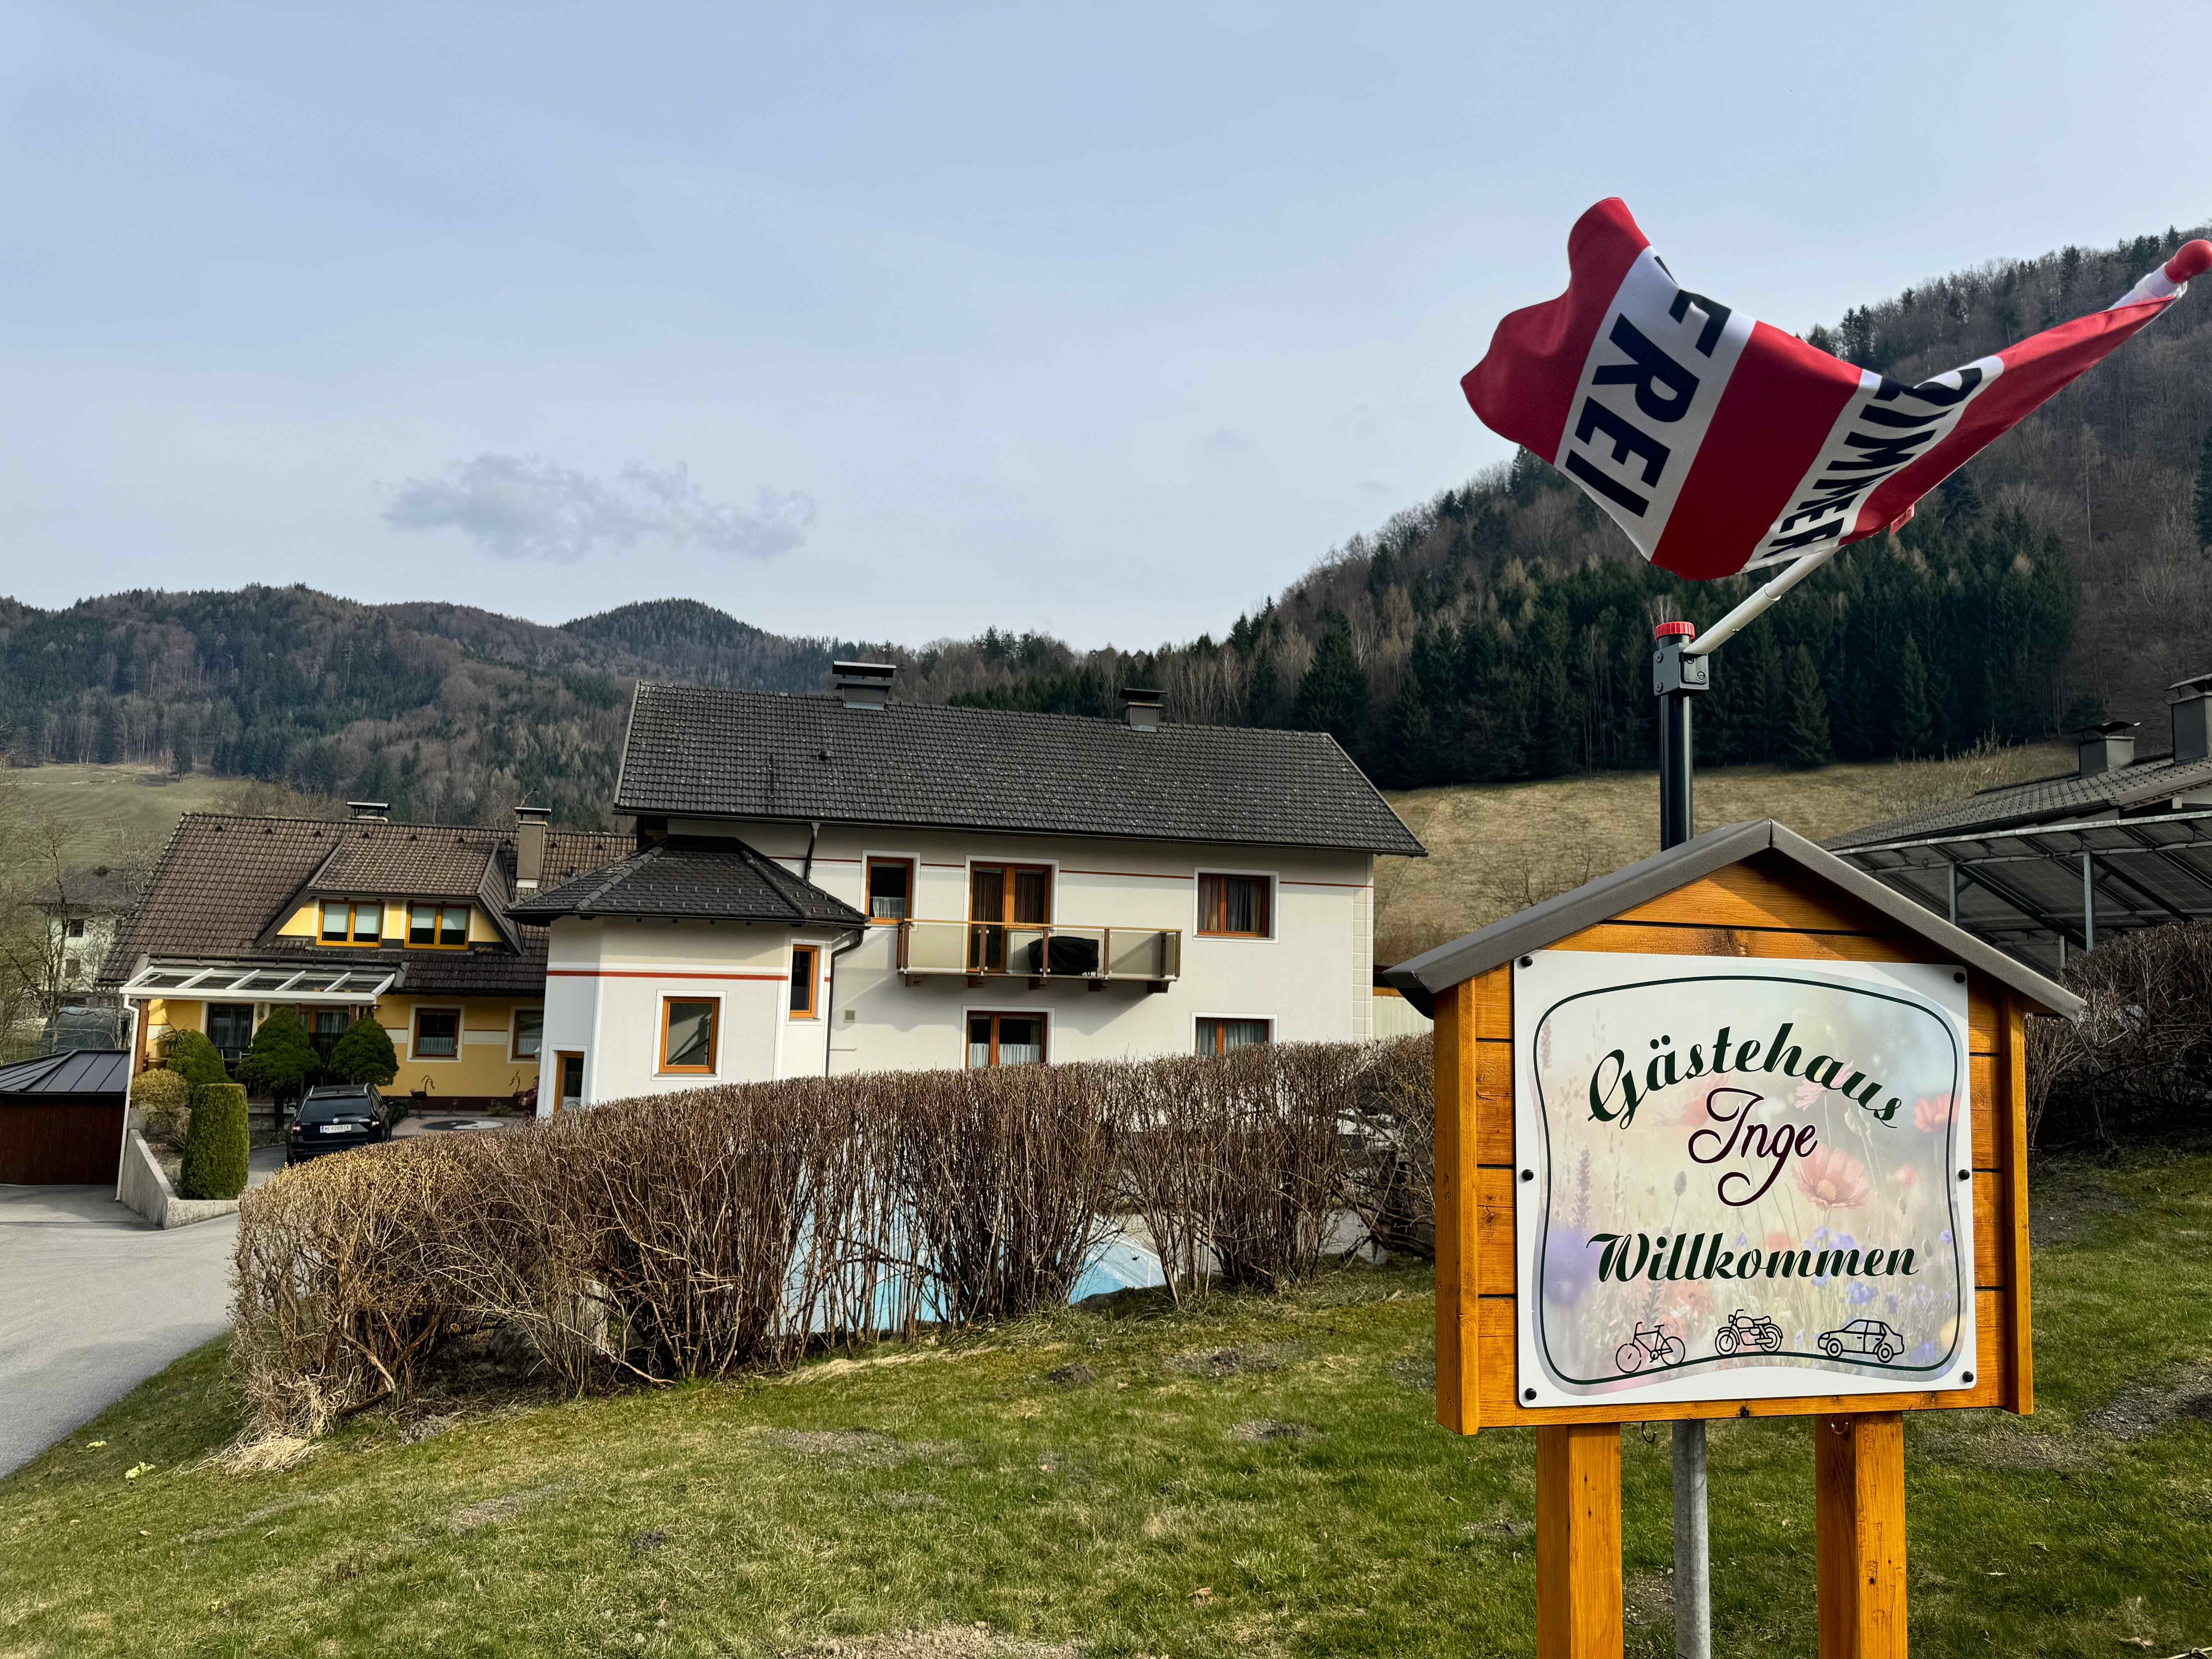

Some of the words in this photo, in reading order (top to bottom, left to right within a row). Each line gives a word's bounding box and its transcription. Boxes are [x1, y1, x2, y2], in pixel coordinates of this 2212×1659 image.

[1565, 256, 1732, 518] FREI
[1760, 367, 1983, 559] ZIMMER
[1588, 1023, 1902, 1130] Gästehaus
[1688, 1087, 1818, 1206] Inge
[1586, 1232, 1919, 1282] Willkommen
